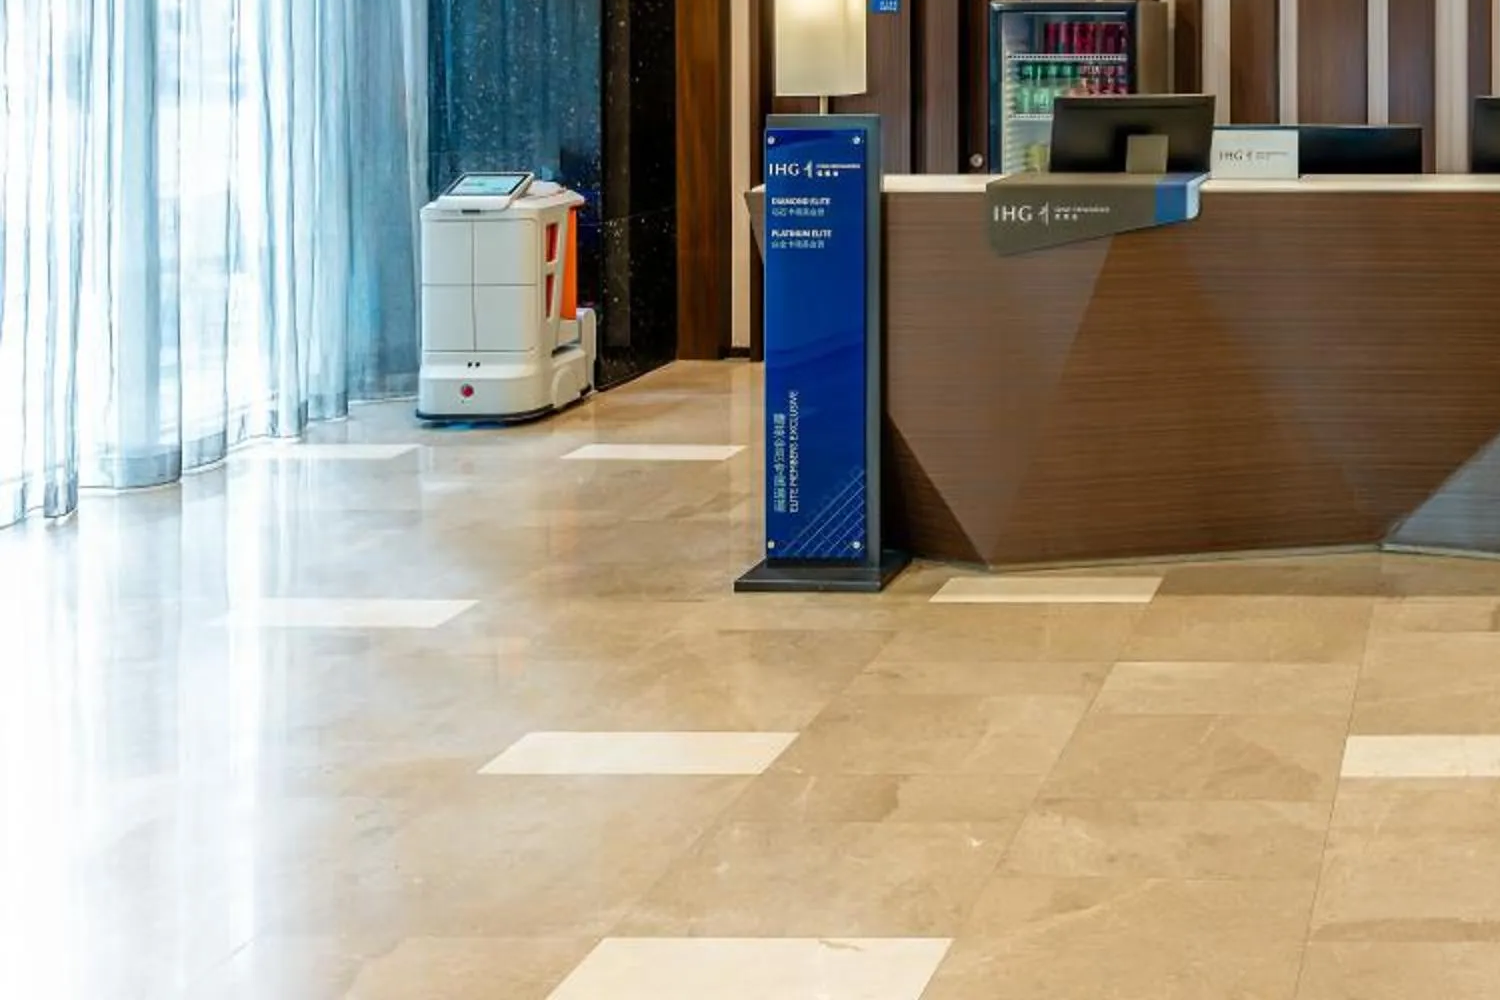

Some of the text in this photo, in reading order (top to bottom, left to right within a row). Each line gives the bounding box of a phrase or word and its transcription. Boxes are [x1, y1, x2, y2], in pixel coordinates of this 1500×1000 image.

[769, 163, 799, 176] IHG
[994, 205, 1033, 222] IHG
[789, 488, 799, 513] ELITE
